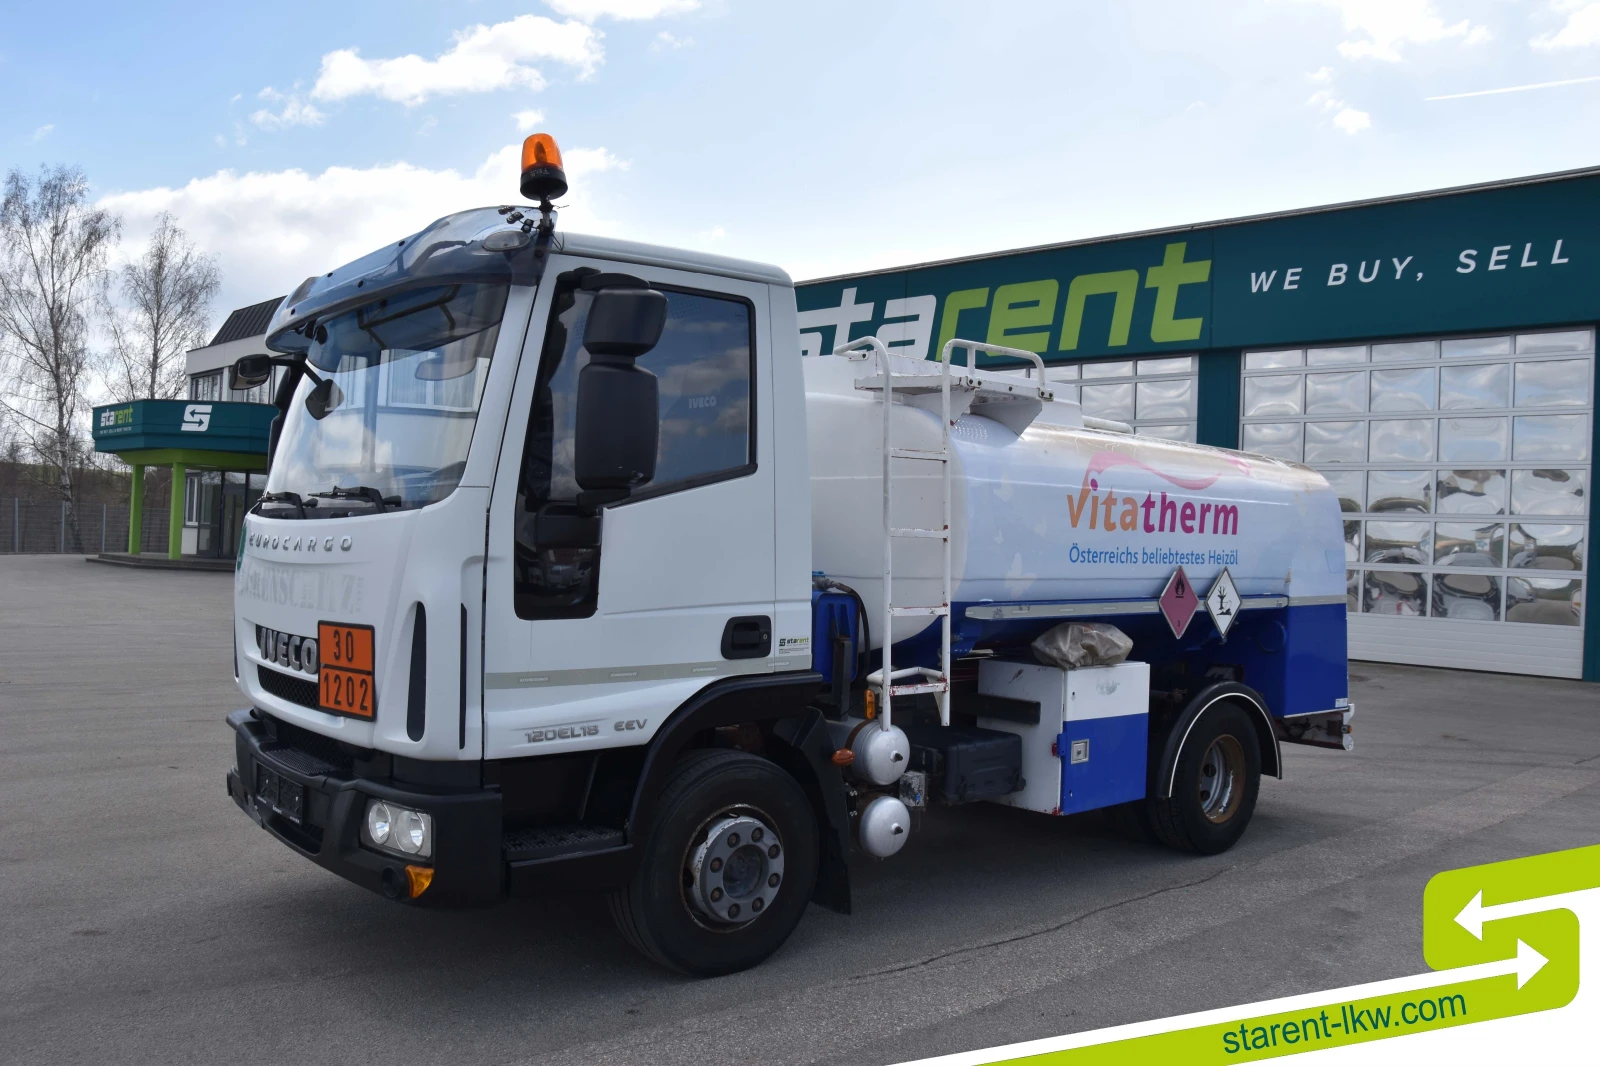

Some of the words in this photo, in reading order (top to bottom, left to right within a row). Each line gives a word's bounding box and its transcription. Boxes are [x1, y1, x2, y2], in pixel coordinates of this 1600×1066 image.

[1250, 268, 1303, 293] WE
[1327, 255, 1424, 286] BUY,
[1456, 239, 1570, 274] SELL
[688, 395, 717, 409] IVECO
[100, 404, 134, 427] starent
[249, 535, 353, 552] EUROCARGO
[1069, 542, 1139, 564] Österreichs
[1142, 547, 1205, 565] beliebtestes
[1208, 549, 1238, 565] Heizöl
[260, 627, 318, 675] IVECO
[333, 629, 355, 662] 30
[323, 672, 369, 712] 1202
[525, 723, 600, 744] 120EL18
[613, 718, 648, 733] EEV
